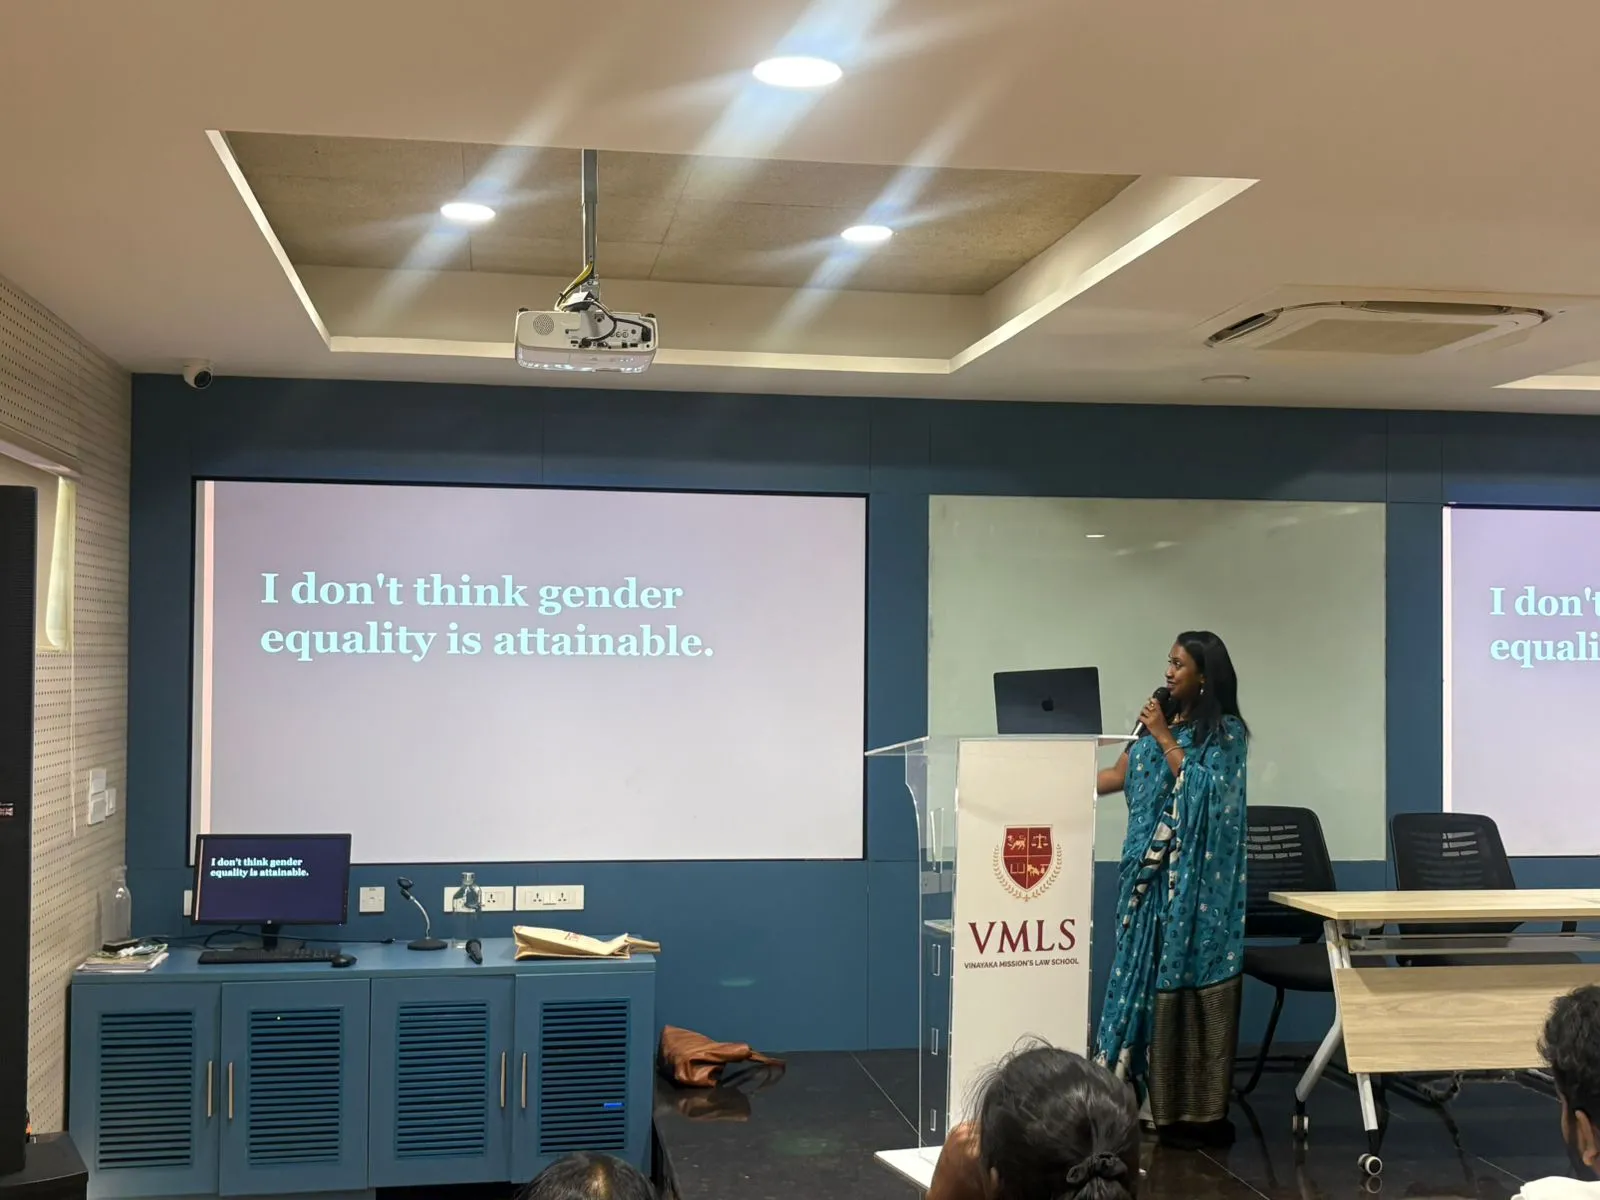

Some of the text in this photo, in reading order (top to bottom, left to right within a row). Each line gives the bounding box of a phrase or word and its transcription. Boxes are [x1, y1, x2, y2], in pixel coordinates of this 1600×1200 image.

[261, 571, 684, 616] I don't think gender
[1489, 587, 1506, 615] I
[260, 621, 714, 662] equality is attainable.
[210, 868, 309, 878] equality is attainable.
[211, 857, 303, 868] I don't think gender
[968, 918, 1076, 955] VMLS
[964, 957, 1079, 969] VINAYAKA MISSION'S LAW SCHOOL
